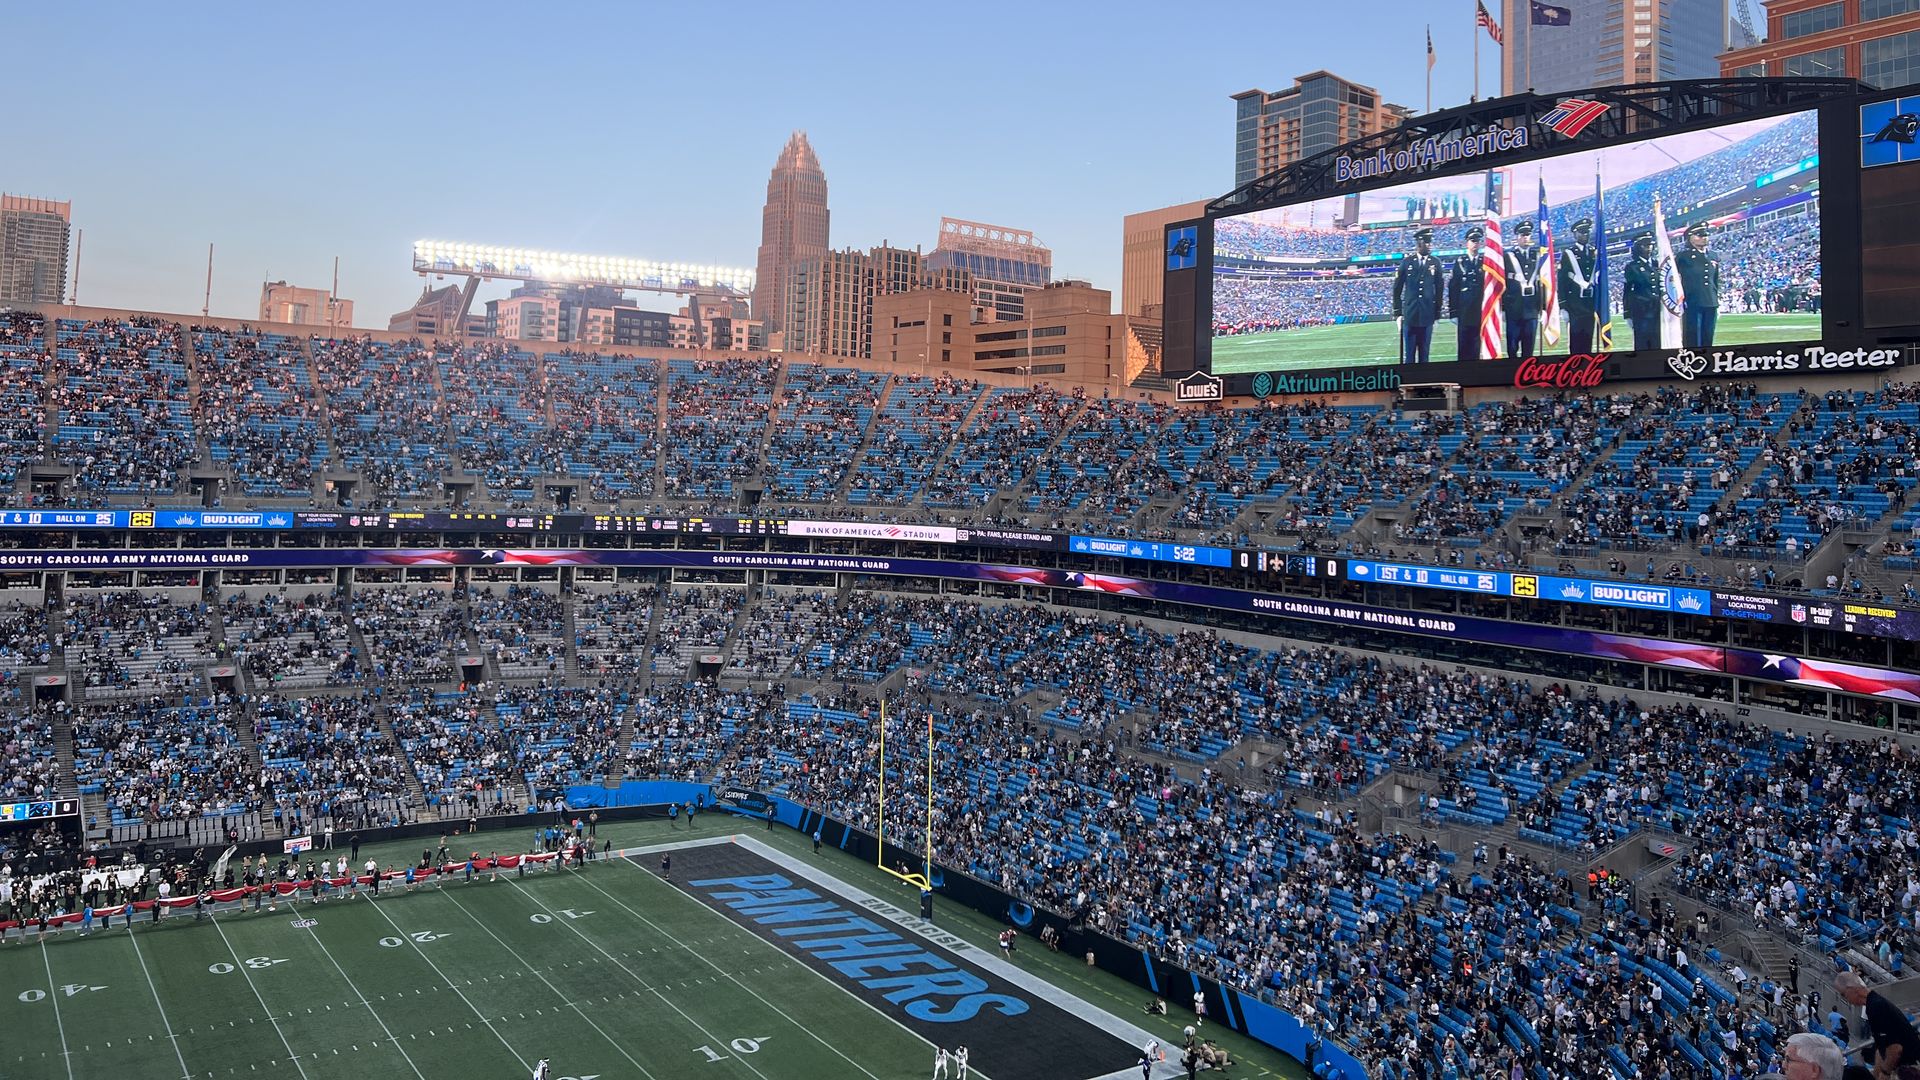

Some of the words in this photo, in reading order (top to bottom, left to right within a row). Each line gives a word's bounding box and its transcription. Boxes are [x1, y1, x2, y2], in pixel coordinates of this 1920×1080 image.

[1336, 149, 1396, 182] Bank
[1392, 141, 1420, 171] of
[1420, 125, 1529, 166] America
[1712, 350, 1799, 373] Harris
[1804, 346, 1900, 369] Teeter
[1514, 354, 1612, 389] Coca-Cola
[1276, 374, 1338, 393] Atrium
[1340, 368, 1400, 391] Health
[14, 514, 22, 523] &
[28, 513, 41, 523] 10
[56, 515, 73, 523] BALL
[74, 515, 86, 523] ON
[96, 513, 112, 524] 25
[132, 513, 152, 526] 25
[203, 515, 228, 525] BUD
[228, 515, 260, 525] LIGHT
[903, 531, 940, 539] STADIUM
[1091, 541, 1105, 550] BUD
[1106, 542, 1125, 552] LIGHT
[0, 556, 42, 564] SOUTH
[47, 555, 108, 564] CAROLINA
[112, 555, 147, 563] ARMY
[150, 554, 207, 563] NATIONAL
[212, 554, 249, 562] GUARD
[1174, 546, 1194, 561] 5:22
[1240, 553, 1248, 567] 0
[745, 557, 788, 565] CAROLINA
[791, 558, 815, 566] ARMY
[818, 560, 859, 568] NATIONAL
[1327, 560, 1336, 576] 0
[1381, 567, 1398, 580] 1ST
[1404, 569, 1411, 580] &
[1416, 570, 1428, 583] 10
[1441, 574, 1457, 584] BALL
[1458, 576, 1468, 584] ON
[1478, 576, 1492, 589] 25
[1513, 576, 1536, 596] 25
[1594, 586, 1623, 599] BUD
[1624, 589, 1667, 604] LIGHT
[1253, 599, 1281, 610] SOUTH
[1285, 603, 1330, 616] CAROLINA
[1334, 608, 1360, 620] ARMY
[1364, 612, 1415, 627] NATIONAL
[1419, 619, 1455, 632] GUARD
[1721, 609, 1772, 620] 704-GET-HELP
[1810, 607, 1832, 616] IN-GAME
[1845, 605, 1867, 615] LEADING
[1867, 607, 1896, 618] RECEIVERS
[1845, 614, 1856, 622] CAR
[1814, 616, 1829, 624] STATS
[1737, 708, 1750, 716] 232
[860, 899, 899, 914] END
[895, 916, 972, 952] RACISM
[688, 873, 1030, 1022] PANTHERS
